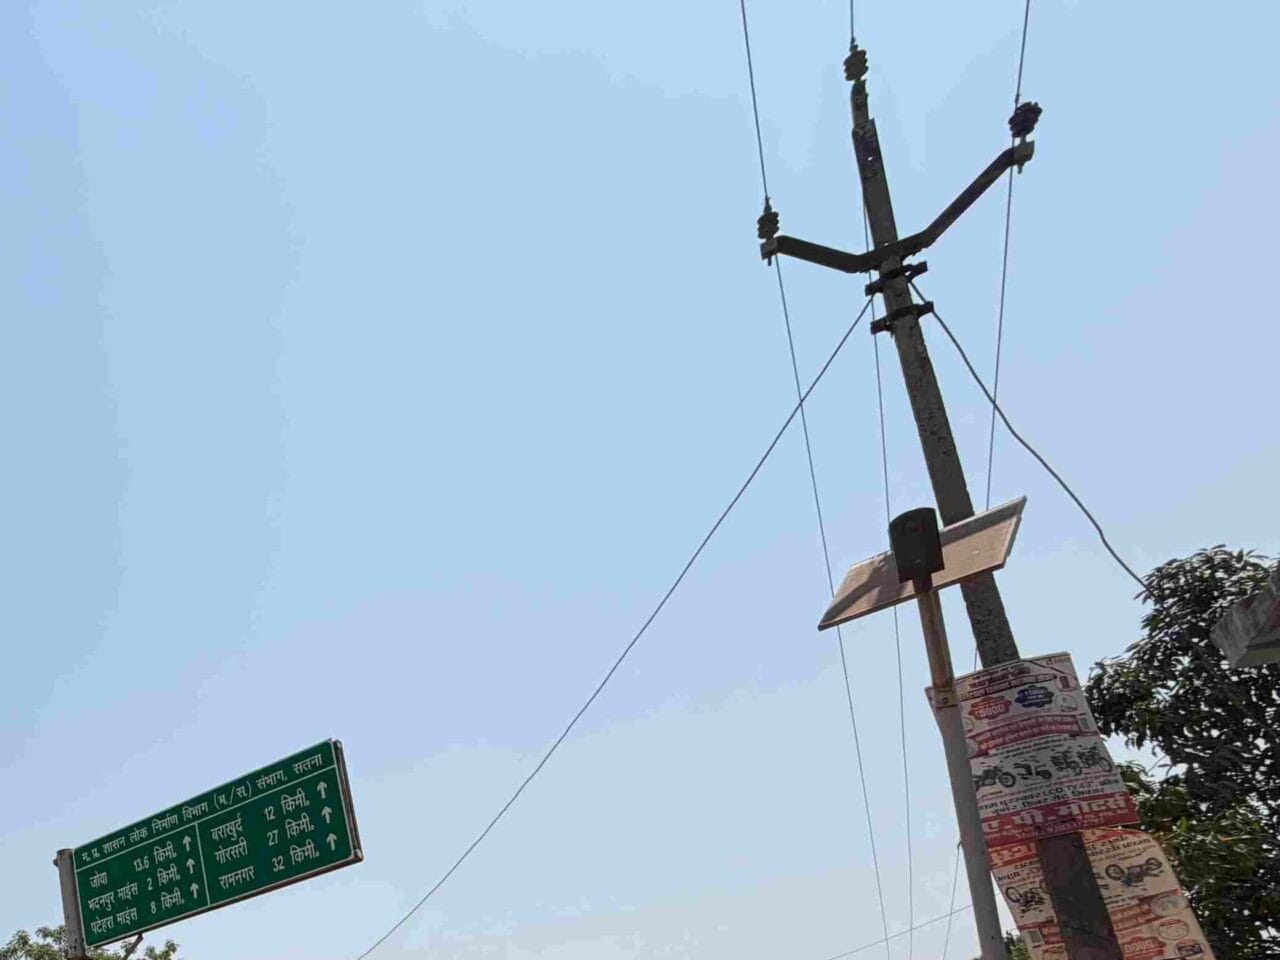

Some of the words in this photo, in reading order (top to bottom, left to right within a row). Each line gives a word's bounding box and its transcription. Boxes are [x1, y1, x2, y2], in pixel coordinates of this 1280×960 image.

[102, 836, 126, 854] शासन
[128, 827, 148, 843] लोक
[151, 813, 179, 834] निर्माण
[182, 805, 208, 822] विभाग
[292, 753, 323, 774] सतना
[264, 805, 277, 821] 12
[214, 837, 249, 864] गोरसरी
[267, 829, 279, 846] 27
[133, 855, 150, 872] 13.6
[218, 865, 256, 890] रामनगर
[272, 855, 286, 872] 32
[146, 877, 153, 891] 2
[150, 900, 157, 915] 8
